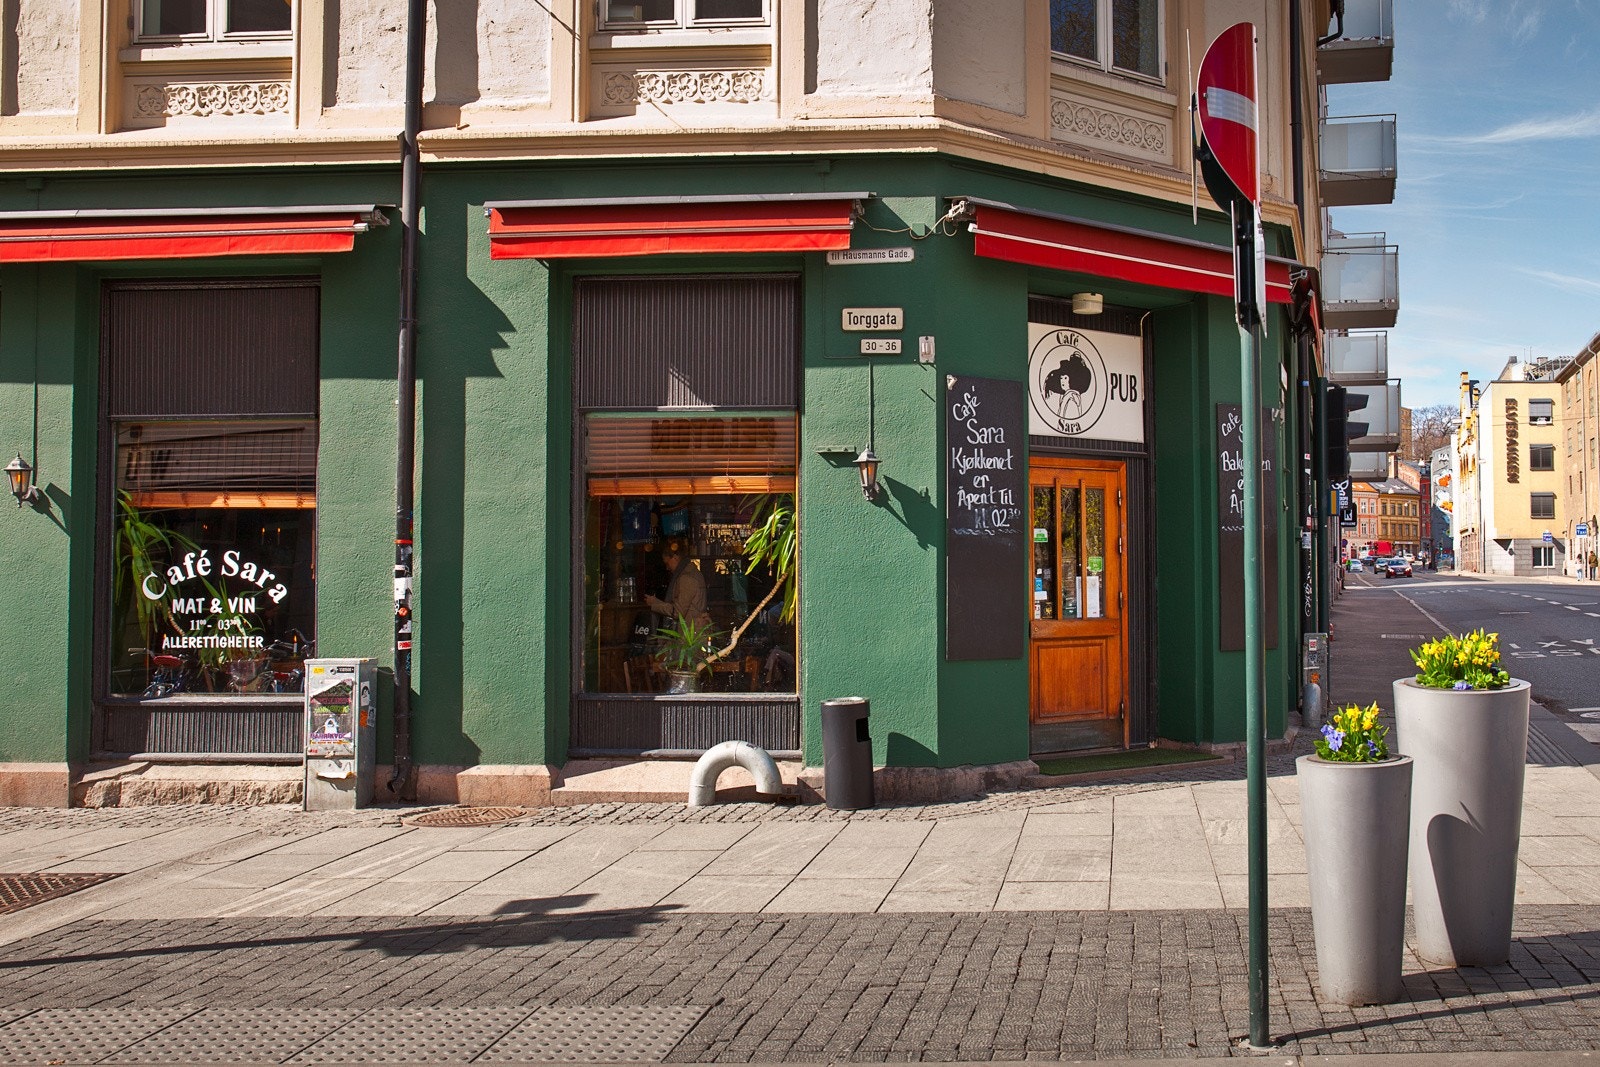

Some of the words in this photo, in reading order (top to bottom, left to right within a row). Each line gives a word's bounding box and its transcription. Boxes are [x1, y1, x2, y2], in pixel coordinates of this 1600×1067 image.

[842, 250, 886, 260] Hausmanns
[847, 311, 897, 328] Torggata
[1056, 332, 1079, 346] Café
[1110, 372, 1138, 403] PUB
[952, 385, 981, 421] Café
[966, 418, 1005, 445] Sara
[1058, 418, 1081, 433] Sara
[1221, 407, 1241, 437] Café
[1505, 398, 1520, 484] ELVEBAKKEN
[952, 447, 1014, 475] Kjøkkenet
[973, 474, 990, 489] er
[957, 486, 997, 511] Åpent
[998, 488, 1015, 506] Til
[142, 549, 212, 600] Café
[220, 550, 288, 604] Sara
[172, 597, 205, 615] MAT
[209, 597, 223, 614] &
[227, 597, 256, 614] VIN
[635, 625, 650, 635] Lee
[162, 635, 264, 649] ALLERETTIGHETER
